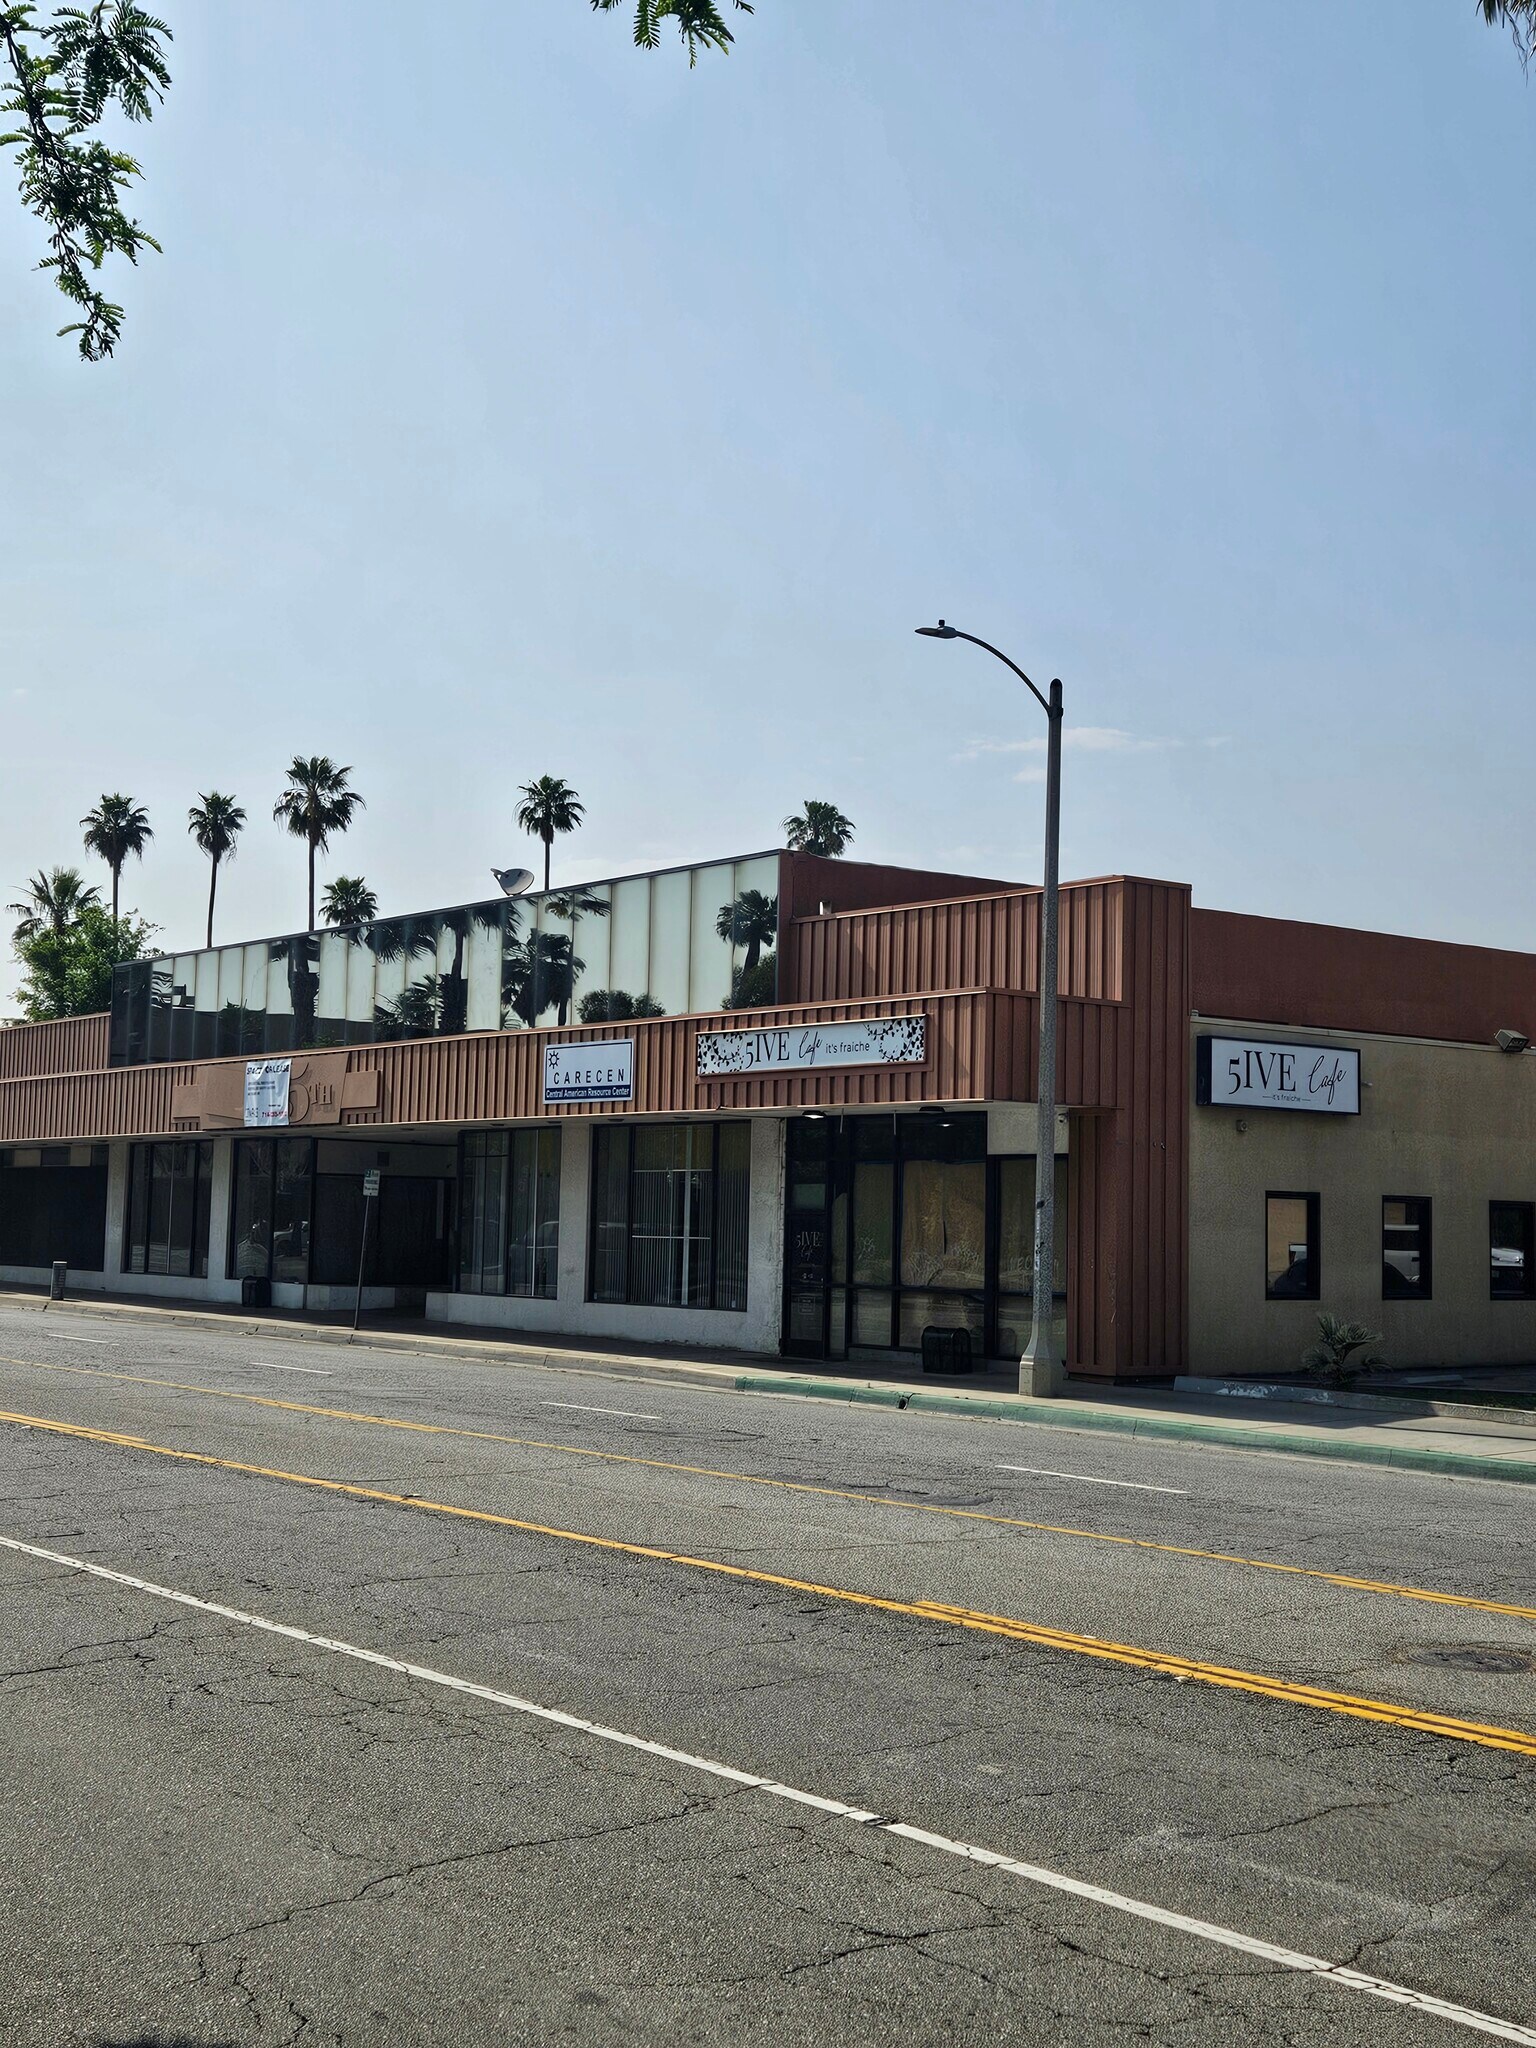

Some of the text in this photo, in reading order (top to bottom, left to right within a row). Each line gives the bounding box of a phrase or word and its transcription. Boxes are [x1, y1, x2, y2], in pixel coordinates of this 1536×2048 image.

[745, 1030, 870, 1069] 5IVE Cafe it's fraiche
[553, 1068, 625, 1085] CARECEN
[1229, 1050, 1347, 1105] 5IVE Cafe
[546, 1087, 630, 1098] Central American Resource Center
